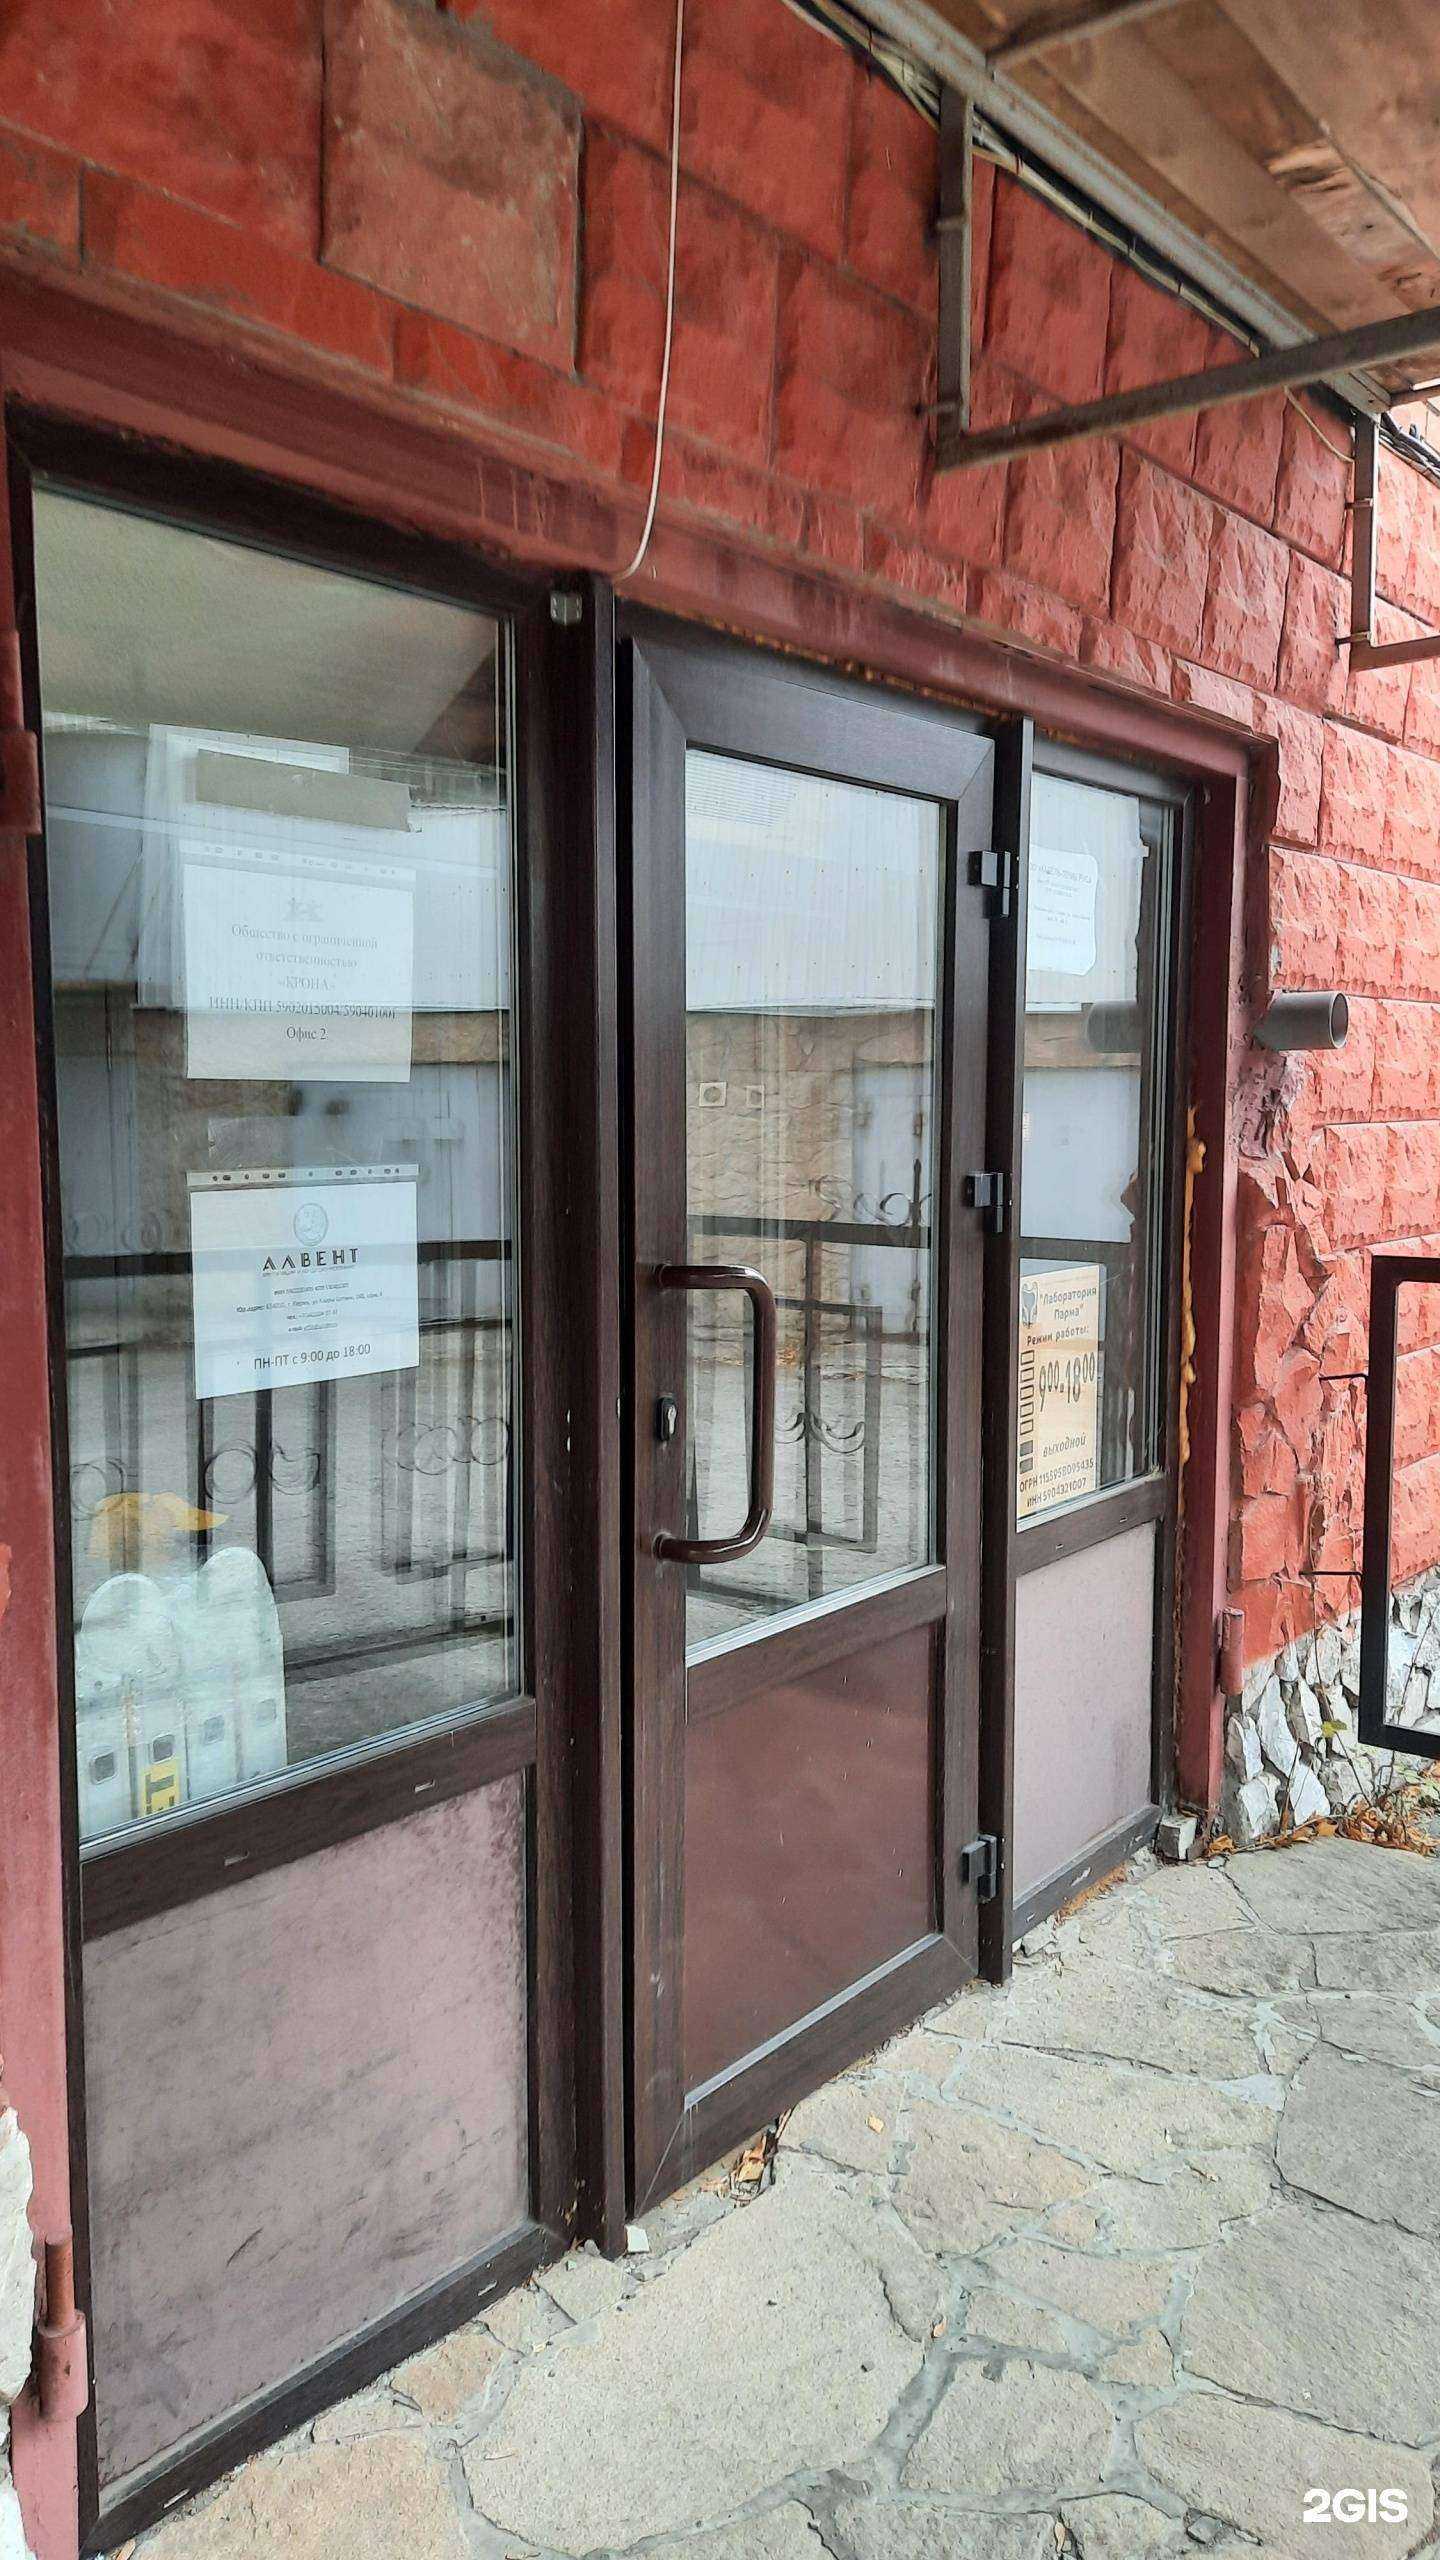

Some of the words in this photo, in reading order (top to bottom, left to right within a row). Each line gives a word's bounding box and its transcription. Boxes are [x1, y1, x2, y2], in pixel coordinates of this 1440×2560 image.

[286, 1026, 317, 1043] Офис
[319, 1027, 327, 1040] 2
[262, 1247, 359, 1272] АЛВЕНТ
[1027, 1332, 1053, 1345] Режим
[1055, 1325, 1089, 1343] работы:
[253, 1353, 290, 1370] ПН-ПТ
[291, 1355, 298, 1365] с
[300, 1350, 324, 1364] 9:00
[325, 1349, 341, 1362] до
[343, 1343, 371, 1358] 18:00
[1042, 1432, 1087, 1458] выходной
[1019, 1474, 1038, 1493] ОГРН
[1026, 1494, 1042, 1508] ИНН
[1043, 1477, 1087, 1502] 5904321007
